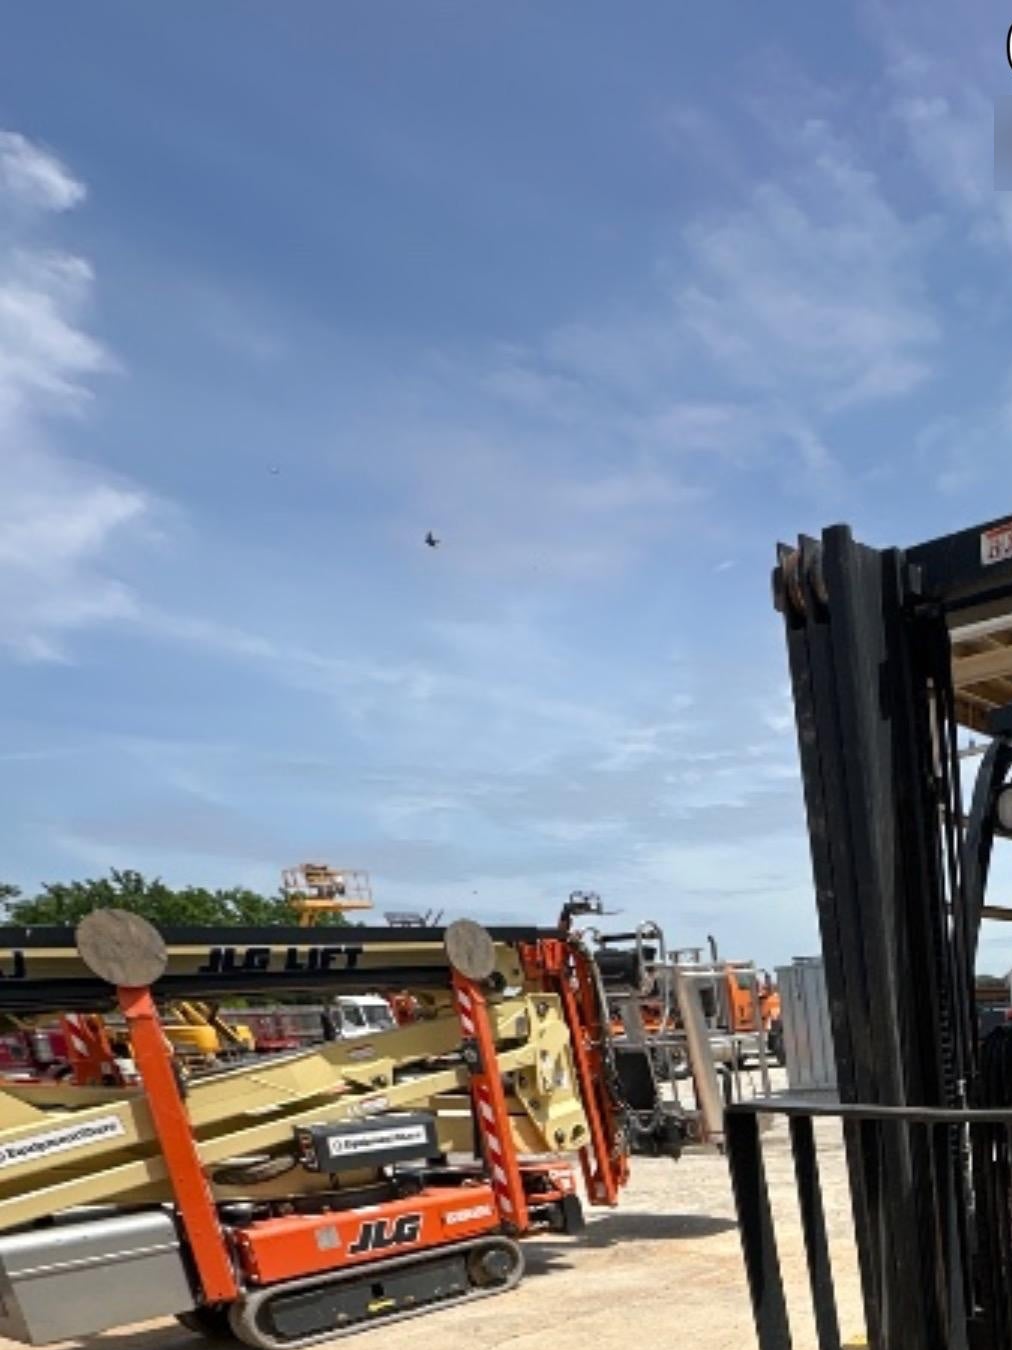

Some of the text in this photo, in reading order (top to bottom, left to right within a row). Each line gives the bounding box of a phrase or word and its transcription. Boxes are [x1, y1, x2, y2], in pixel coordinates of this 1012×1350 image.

[199, 945, 363, 973] JLG LIFT
[347, 1212, 423, 1258] JLG
